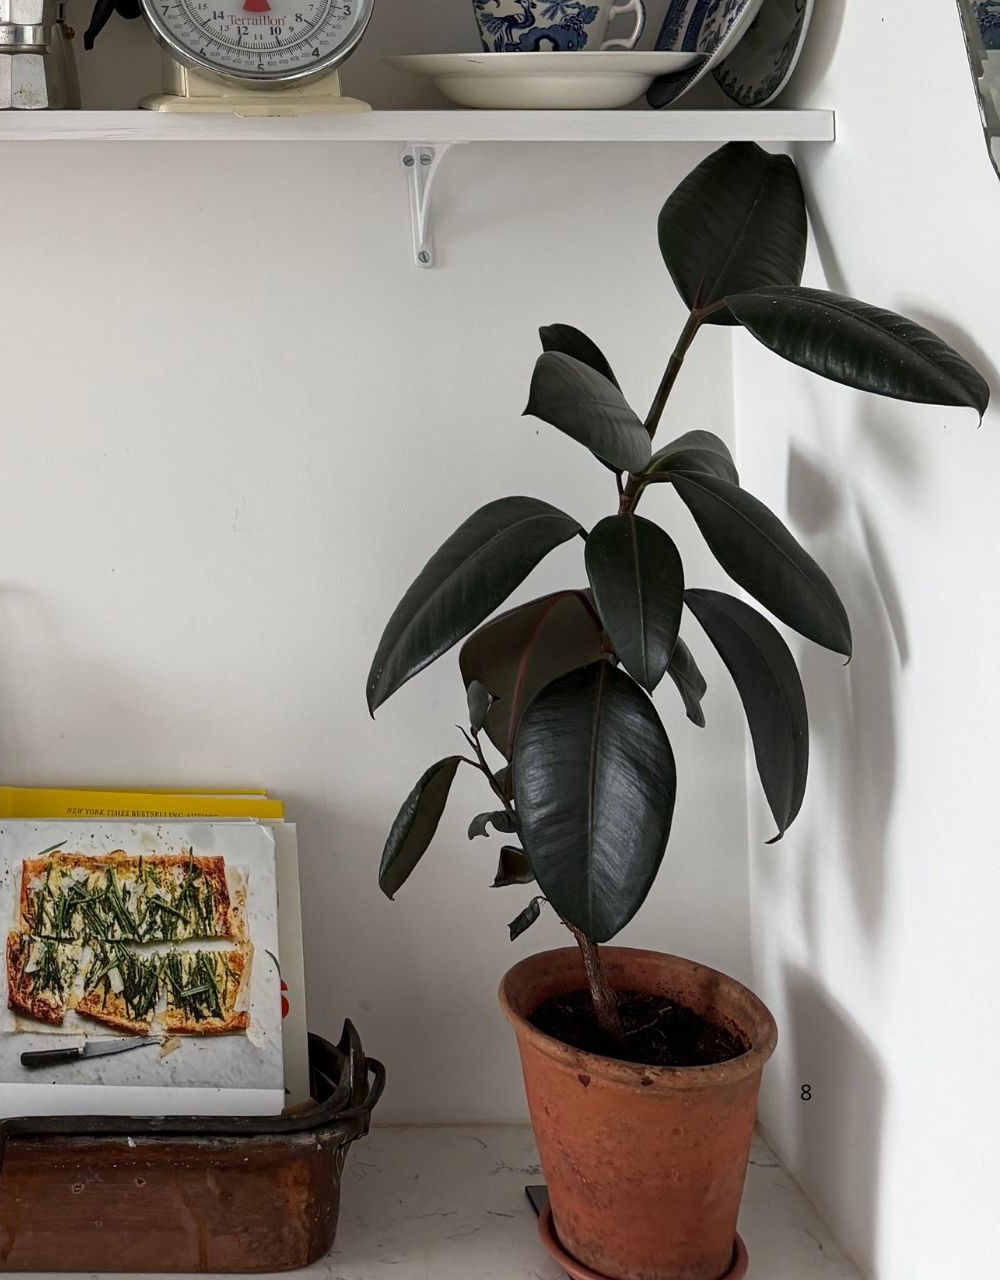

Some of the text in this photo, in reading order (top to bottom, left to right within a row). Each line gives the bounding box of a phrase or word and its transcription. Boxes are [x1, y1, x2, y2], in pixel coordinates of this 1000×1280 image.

[162, 6, 169, 16] 7
[344, 5, 351, 15] 3
[213, 11, 224, 20] 14
[295, 13, 302, 22] 8
[228, 15, 285, 26] Terraillon
[237, 26, 248, 35] 12
[270, 26, 281, 35] 10
[312, 48, 319, 57] 4
[66, 807, 83, 815] NEW
[85, 808, 104, 816] YORK
[105, 809, 129, 817] TIMES
[131, 810, 184, 818] BESTSELLING
